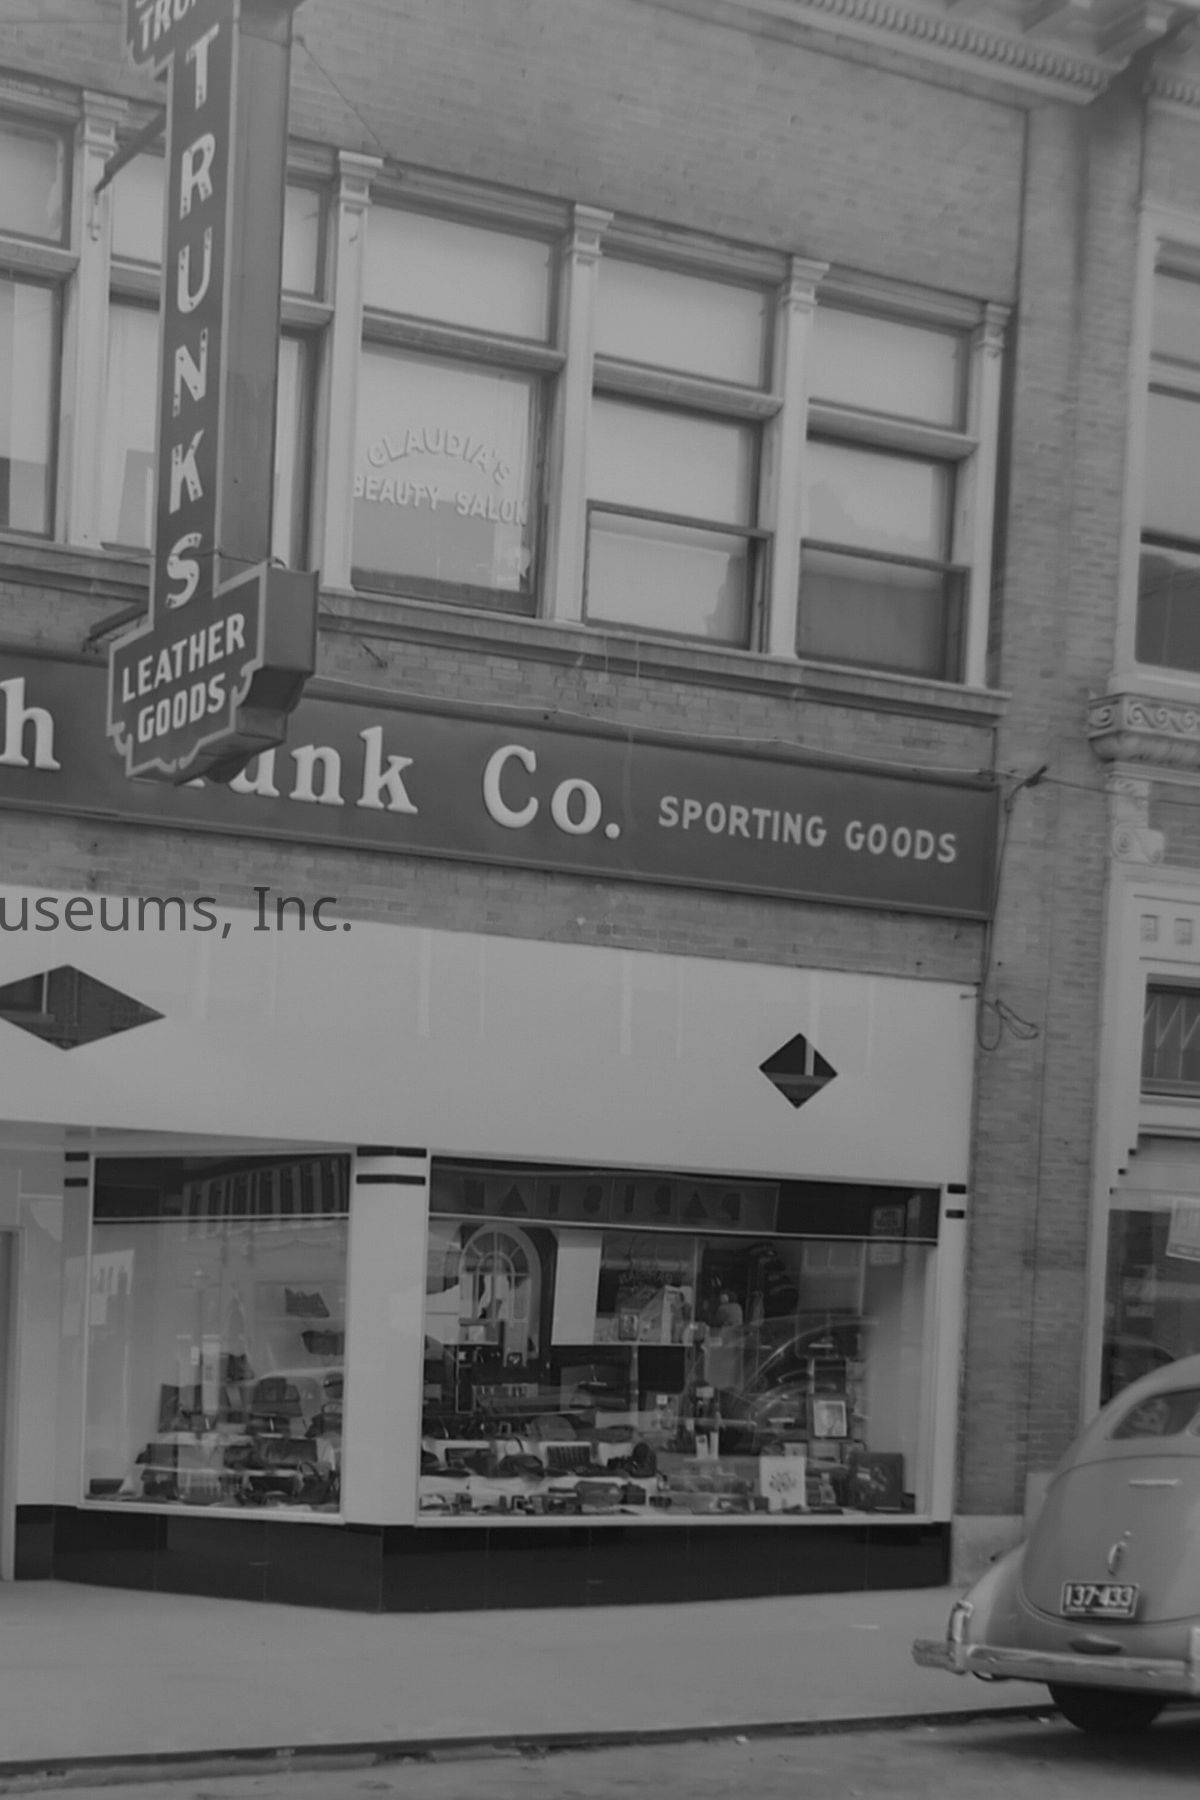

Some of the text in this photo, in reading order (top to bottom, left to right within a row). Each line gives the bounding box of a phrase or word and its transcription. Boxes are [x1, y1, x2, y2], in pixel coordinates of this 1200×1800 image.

[164, 22, 220, 609] TRUNKS
[353, 473, 528, 527] BEAUTY SALON
[367, 427, 510, 487] CLAUDIA'S
[121, 612, 246, 744] LEATHER GOODS
[184, 725, 419, 814] unk
[482, 743, 620, 840] Co.
[658, 795, 957, 864] SPORTING GOODS
